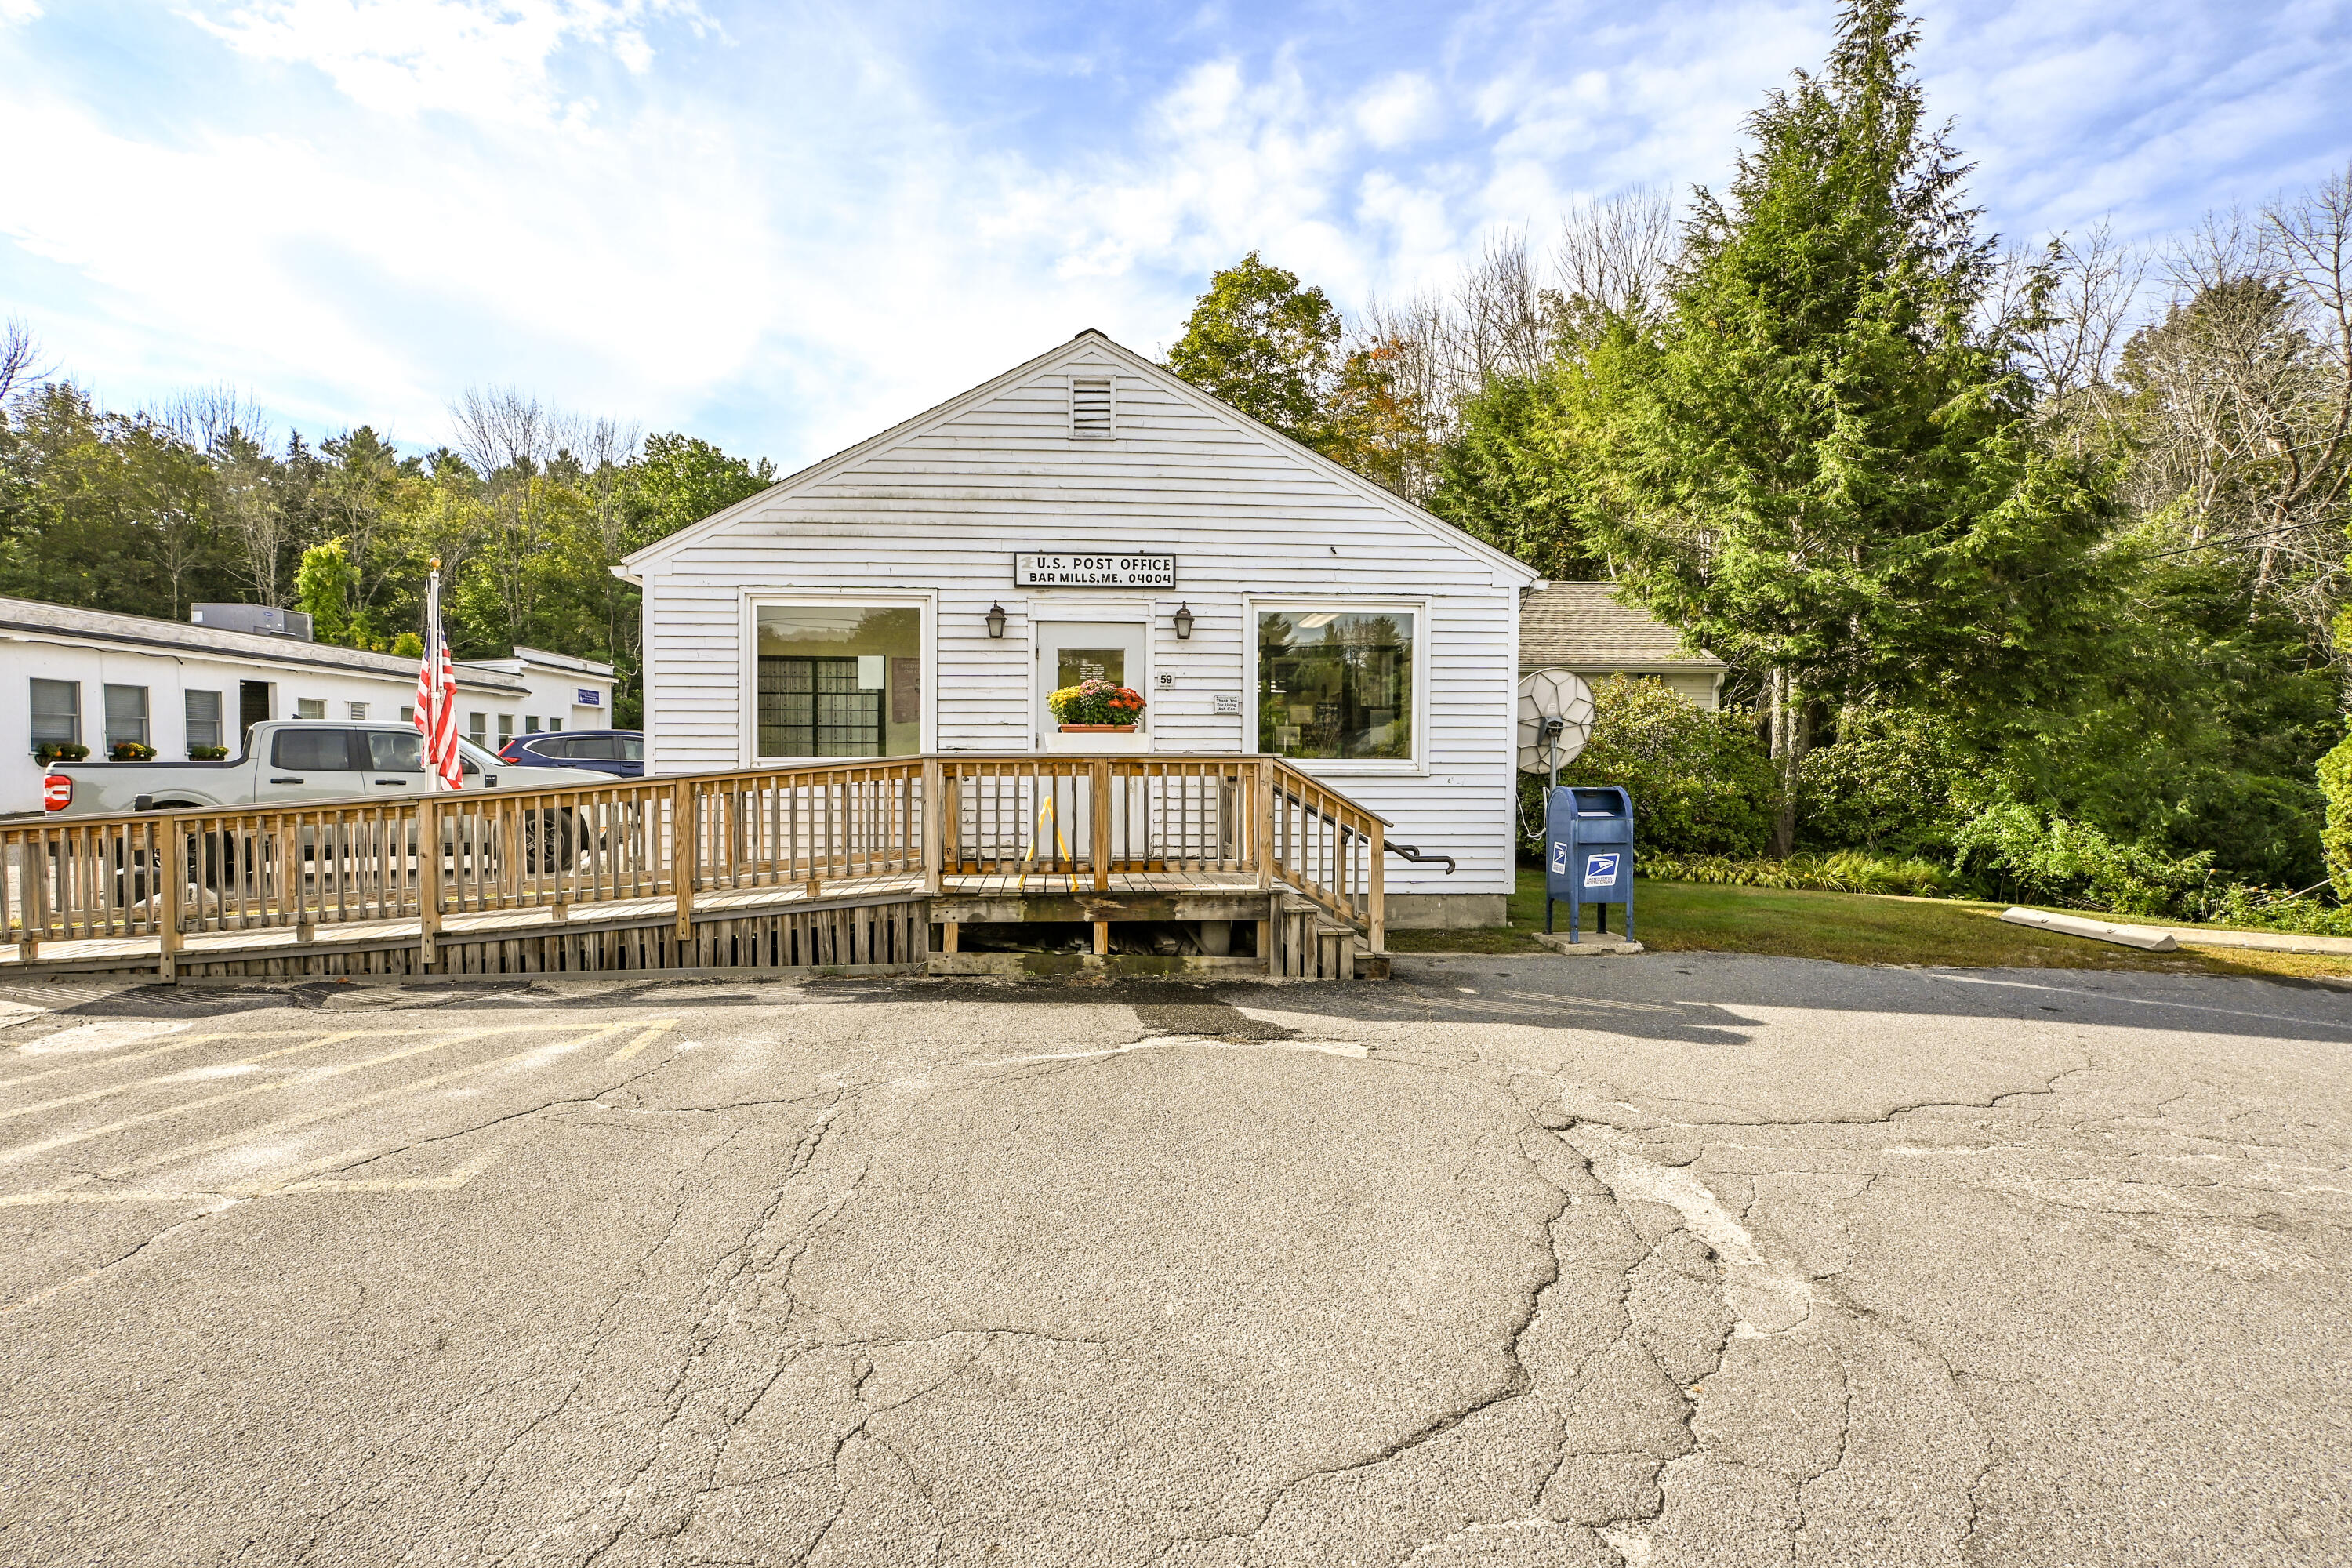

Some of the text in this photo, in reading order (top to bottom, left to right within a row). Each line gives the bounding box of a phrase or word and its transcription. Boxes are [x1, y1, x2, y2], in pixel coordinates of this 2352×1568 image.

[1037, 557, 1171, 571] U.S. POST OFFICE
[1029, 573, 1055, 583] BAR
[1128, 574, 1171, 583] 04004
[1160, 674, 1172, 684] 59
